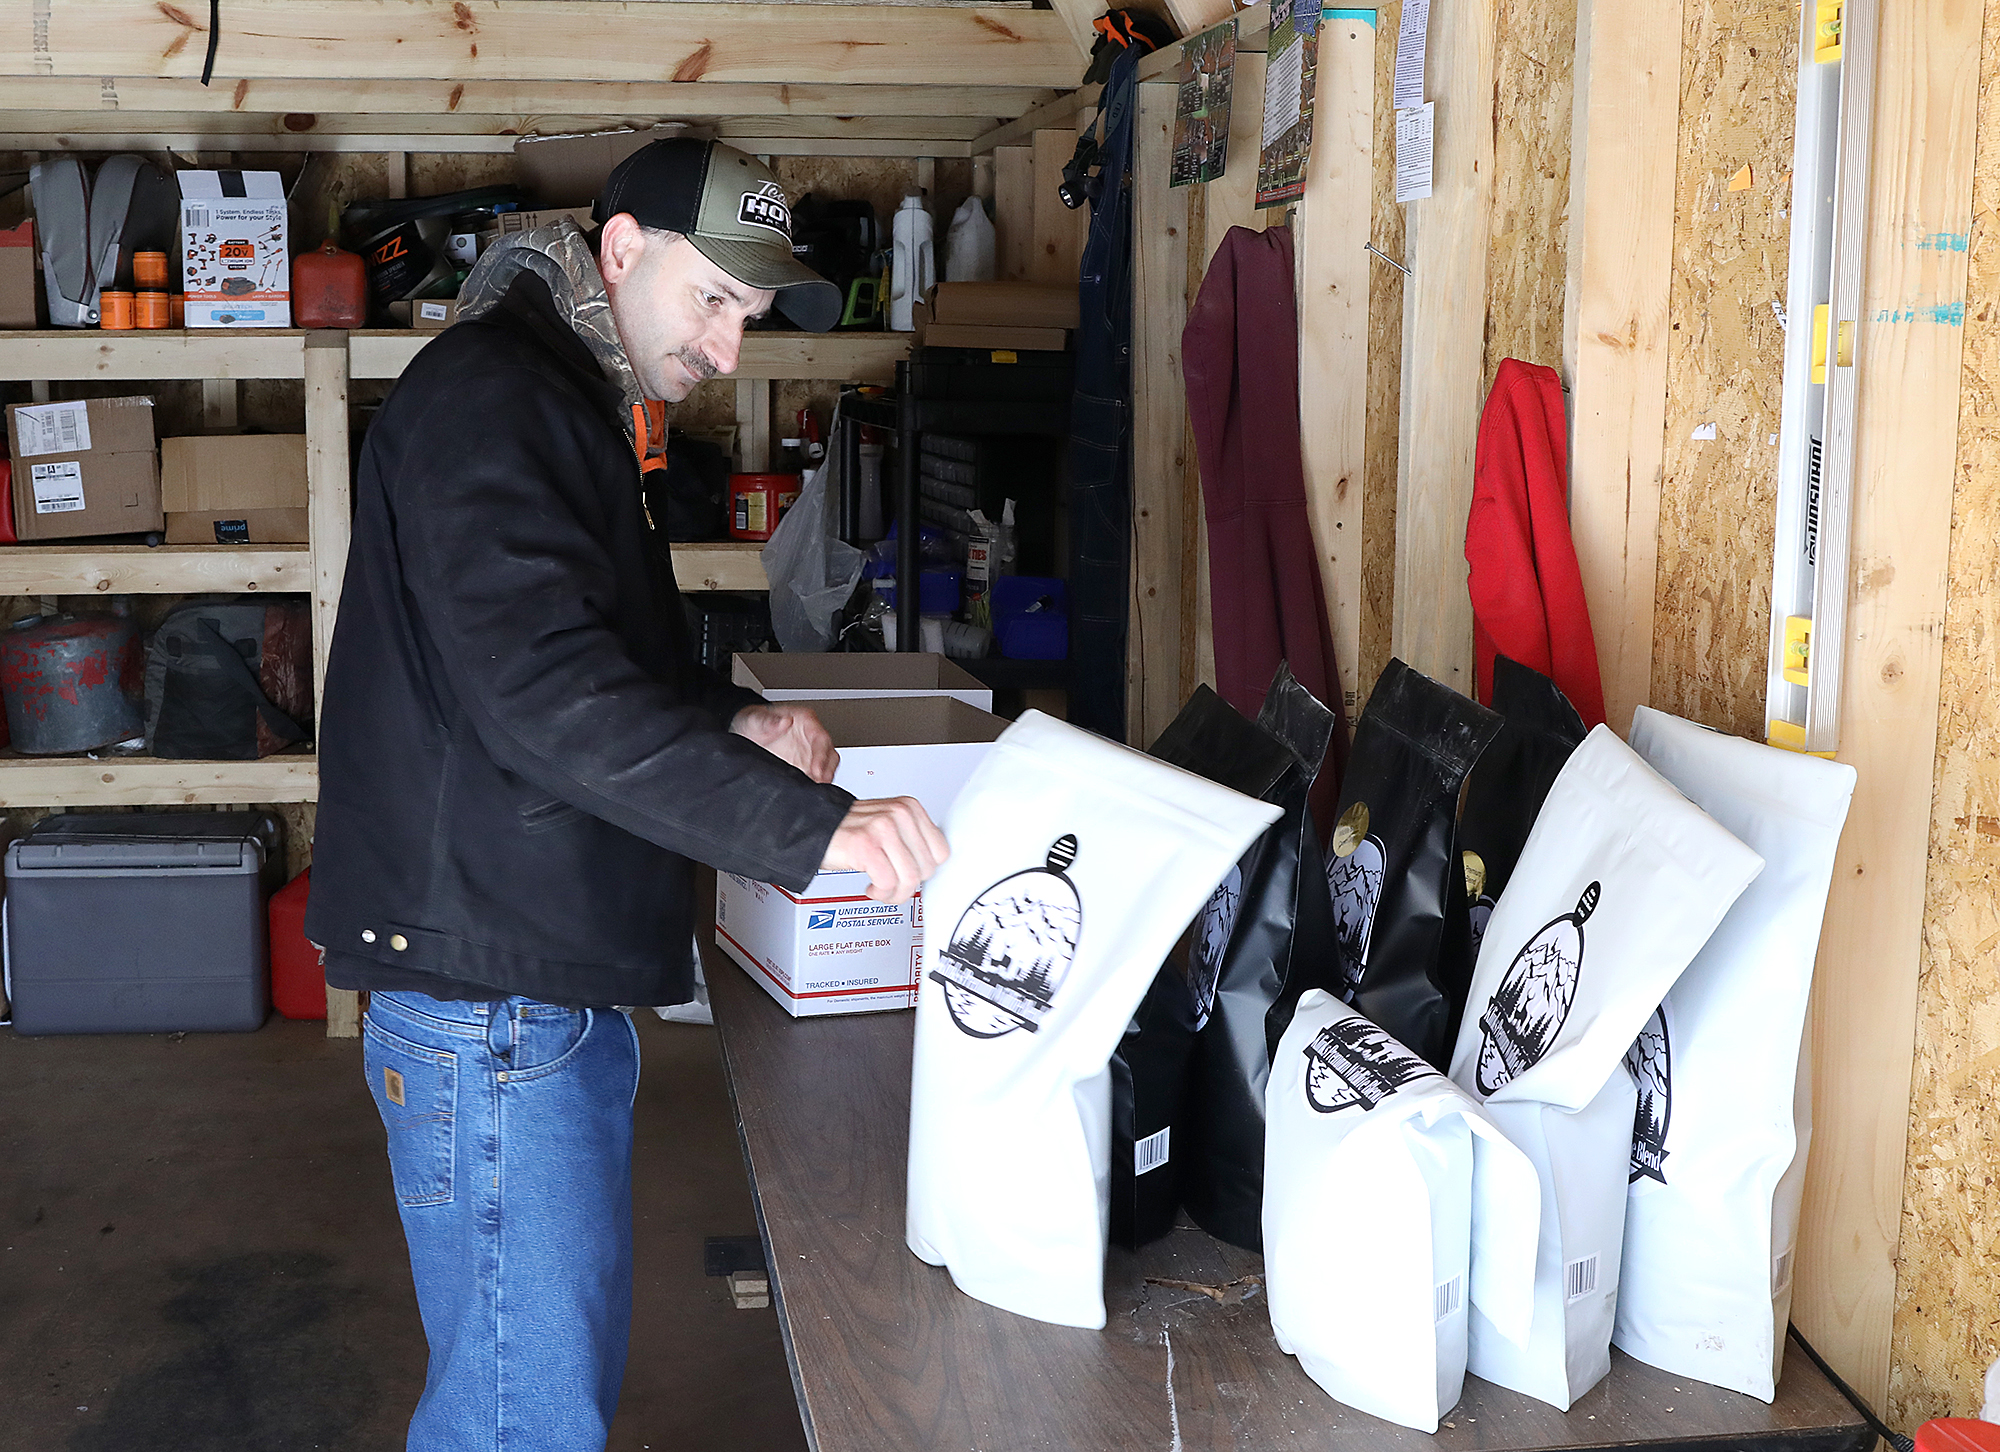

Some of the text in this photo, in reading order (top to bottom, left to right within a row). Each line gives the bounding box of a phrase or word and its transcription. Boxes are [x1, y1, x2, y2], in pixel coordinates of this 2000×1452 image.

[757, 179, 788, 206] Tea
[220, 523, 247, 533] prime
[838, 904, 899, 916] UNITED STATES
[835, 916, 900, 929] POSTAL SERVICE
[808, 939, 892, 952] LARGE FLAT RATE BOX
[806, 977, 879, 989] TRACKED INSURED
[1322, 1044, 1354, 1074] Premium
[1342, 1061, 1376, 1092] Wildlife
[1360, 1079, 1392, 1104] Blend
[1636, 1140, 1662, 1172] Blend
